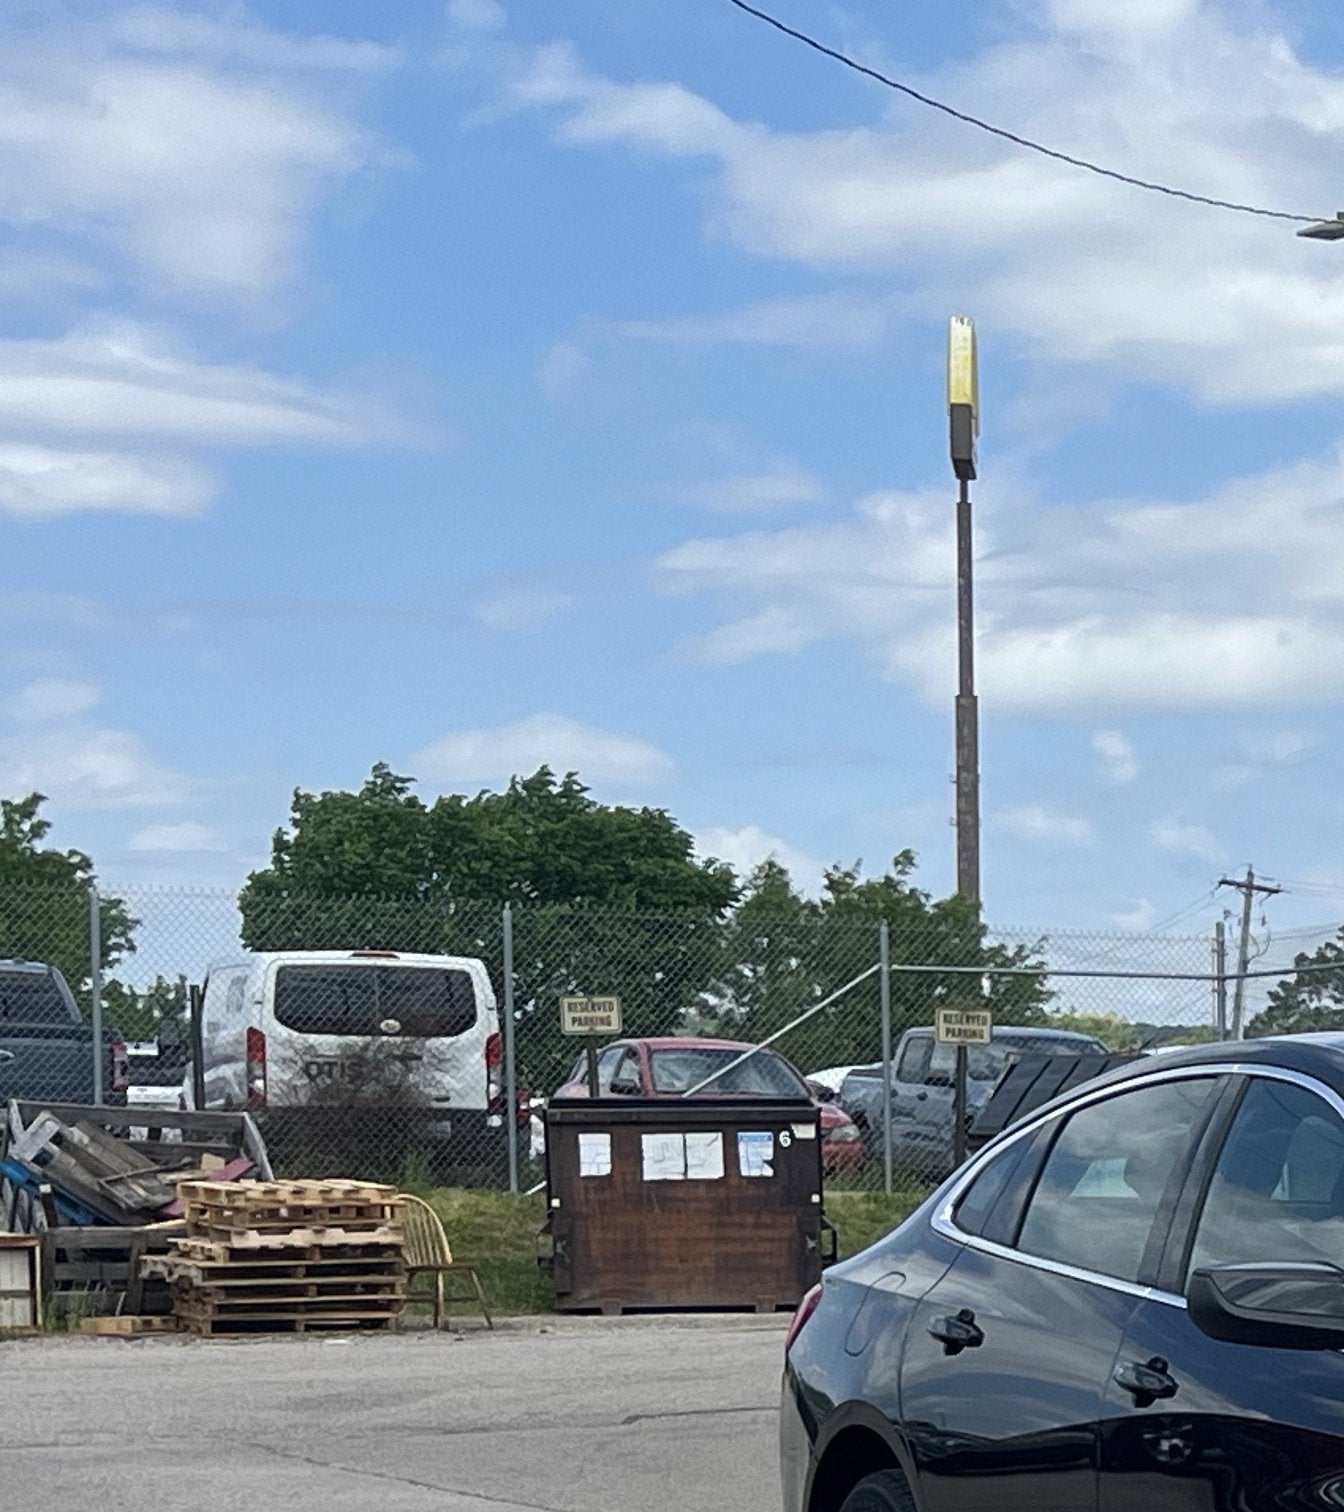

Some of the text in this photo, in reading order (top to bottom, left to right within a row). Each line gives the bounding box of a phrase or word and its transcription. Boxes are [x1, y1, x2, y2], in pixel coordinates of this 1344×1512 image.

[567, 1001, 615, 1012] RESERVED
[571, 1015, 612, 1027] PARKING
[943, 1013, 988, 1025] RESERVED
[944, 1028, 984, 1040] PARKING
[778, 1131, 792, 1147] 6
